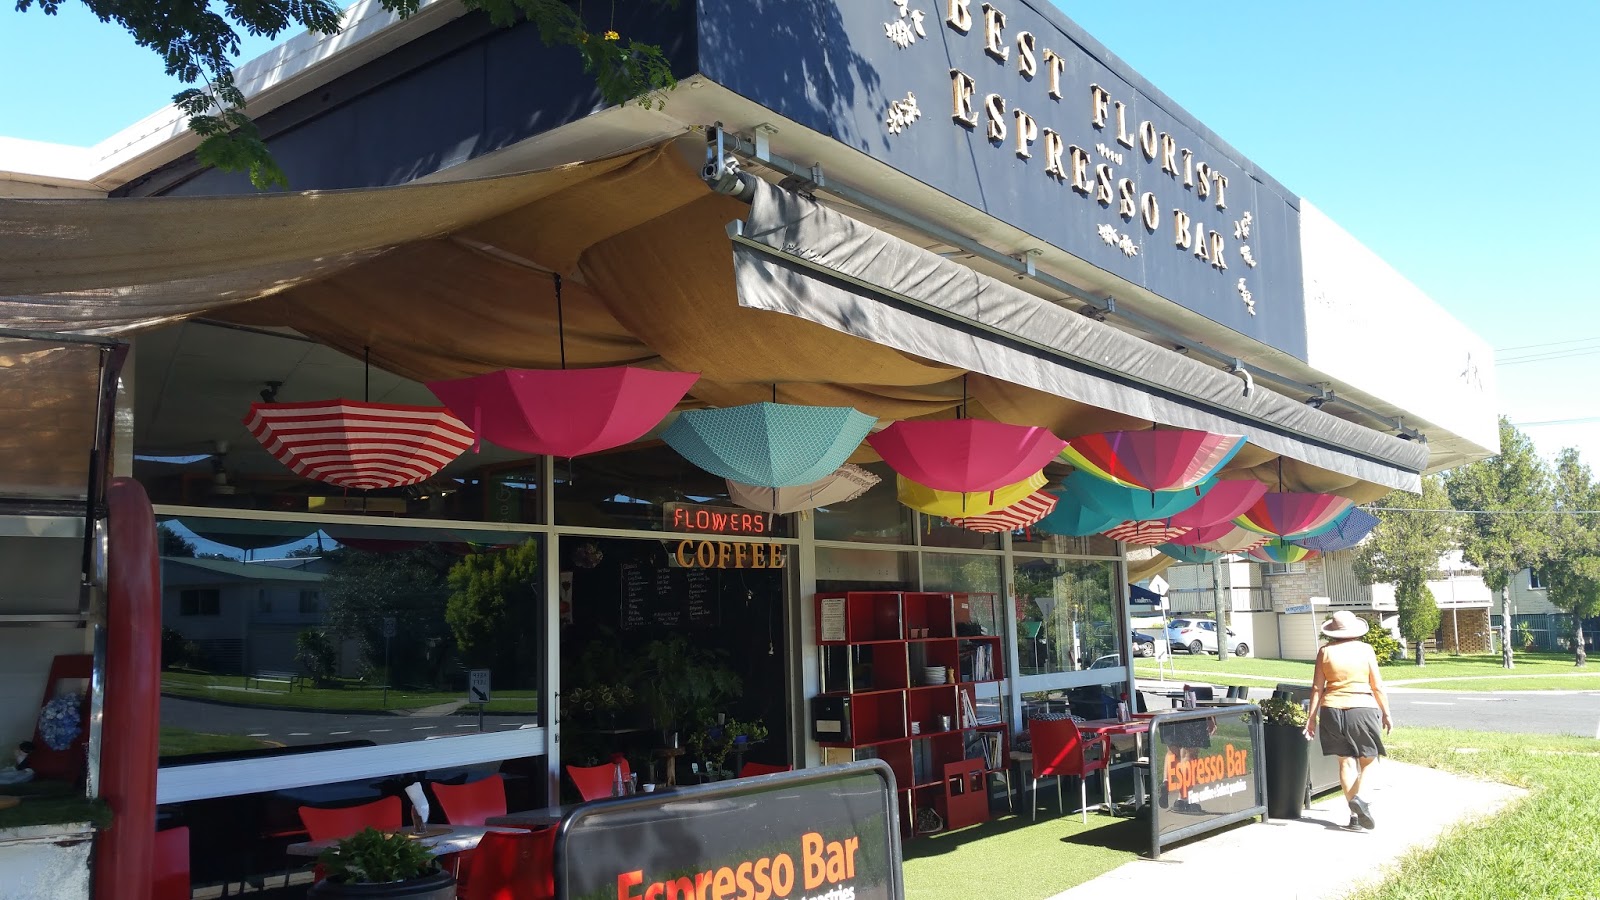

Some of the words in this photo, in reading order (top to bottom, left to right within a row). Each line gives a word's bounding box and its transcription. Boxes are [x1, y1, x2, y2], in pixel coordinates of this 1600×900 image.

[945, 0, 1065, 100] BEST
[1090, 83, 1229, 210] FLORIST
[949, 68, 1160, 231] ESPRESSO
[1173, 208, 1228, 270] BAR
[674, 508, 764, 533] FLOWERS
[676, 539, 784, 569] COFFEE
[1167, 754, 1224, 798] Espresso
[1226, 743, 1247, 778] Bar
[802, 832, 859, 890] Bar
[808, 884, 856, 900] stries
